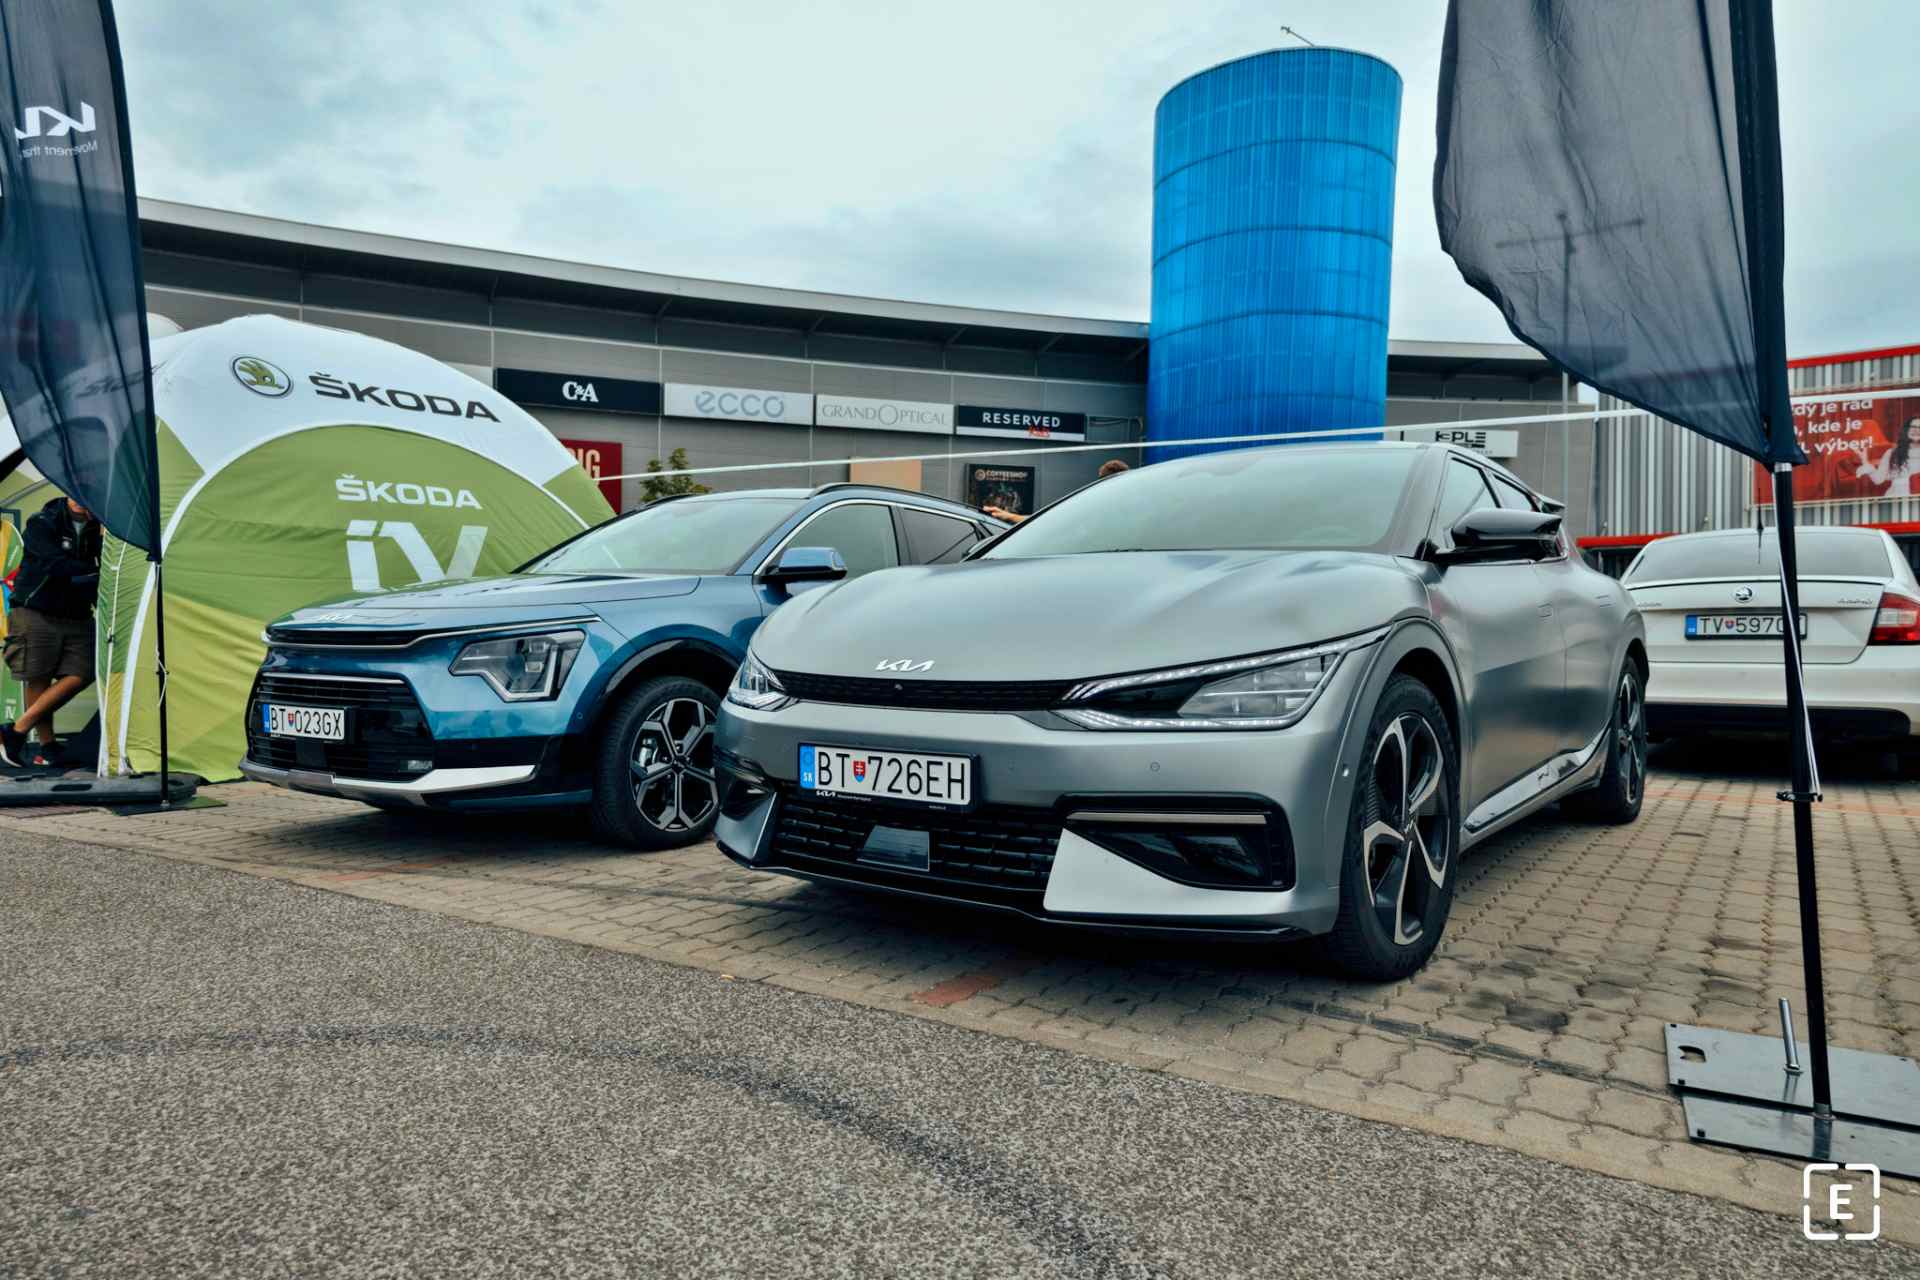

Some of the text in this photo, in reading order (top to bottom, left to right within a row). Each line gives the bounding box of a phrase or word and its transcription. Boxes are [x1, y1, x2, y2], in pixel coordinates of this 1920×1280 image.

[308, 371, 501, 423] ŠKODA
[562, 381, 599, 402] C&A
[695, 390, 785, 419] ecco
[982, 412, 1061, 427] RESERVED
[1808, 420, 1840, 433] kde
[1844, 417, 1862, 434] je
[1815, 436, 1873, 455] výber!
[335, 473, 483, 510] ŠKODA
[1700, 617, 1724, 633] TV
[875, 659, 935, 672] KIA
[271, 707, 342, 737] BT 023GX
[818, 751, 850, 789] BT
[868, 755, 965, 800] 726EH
